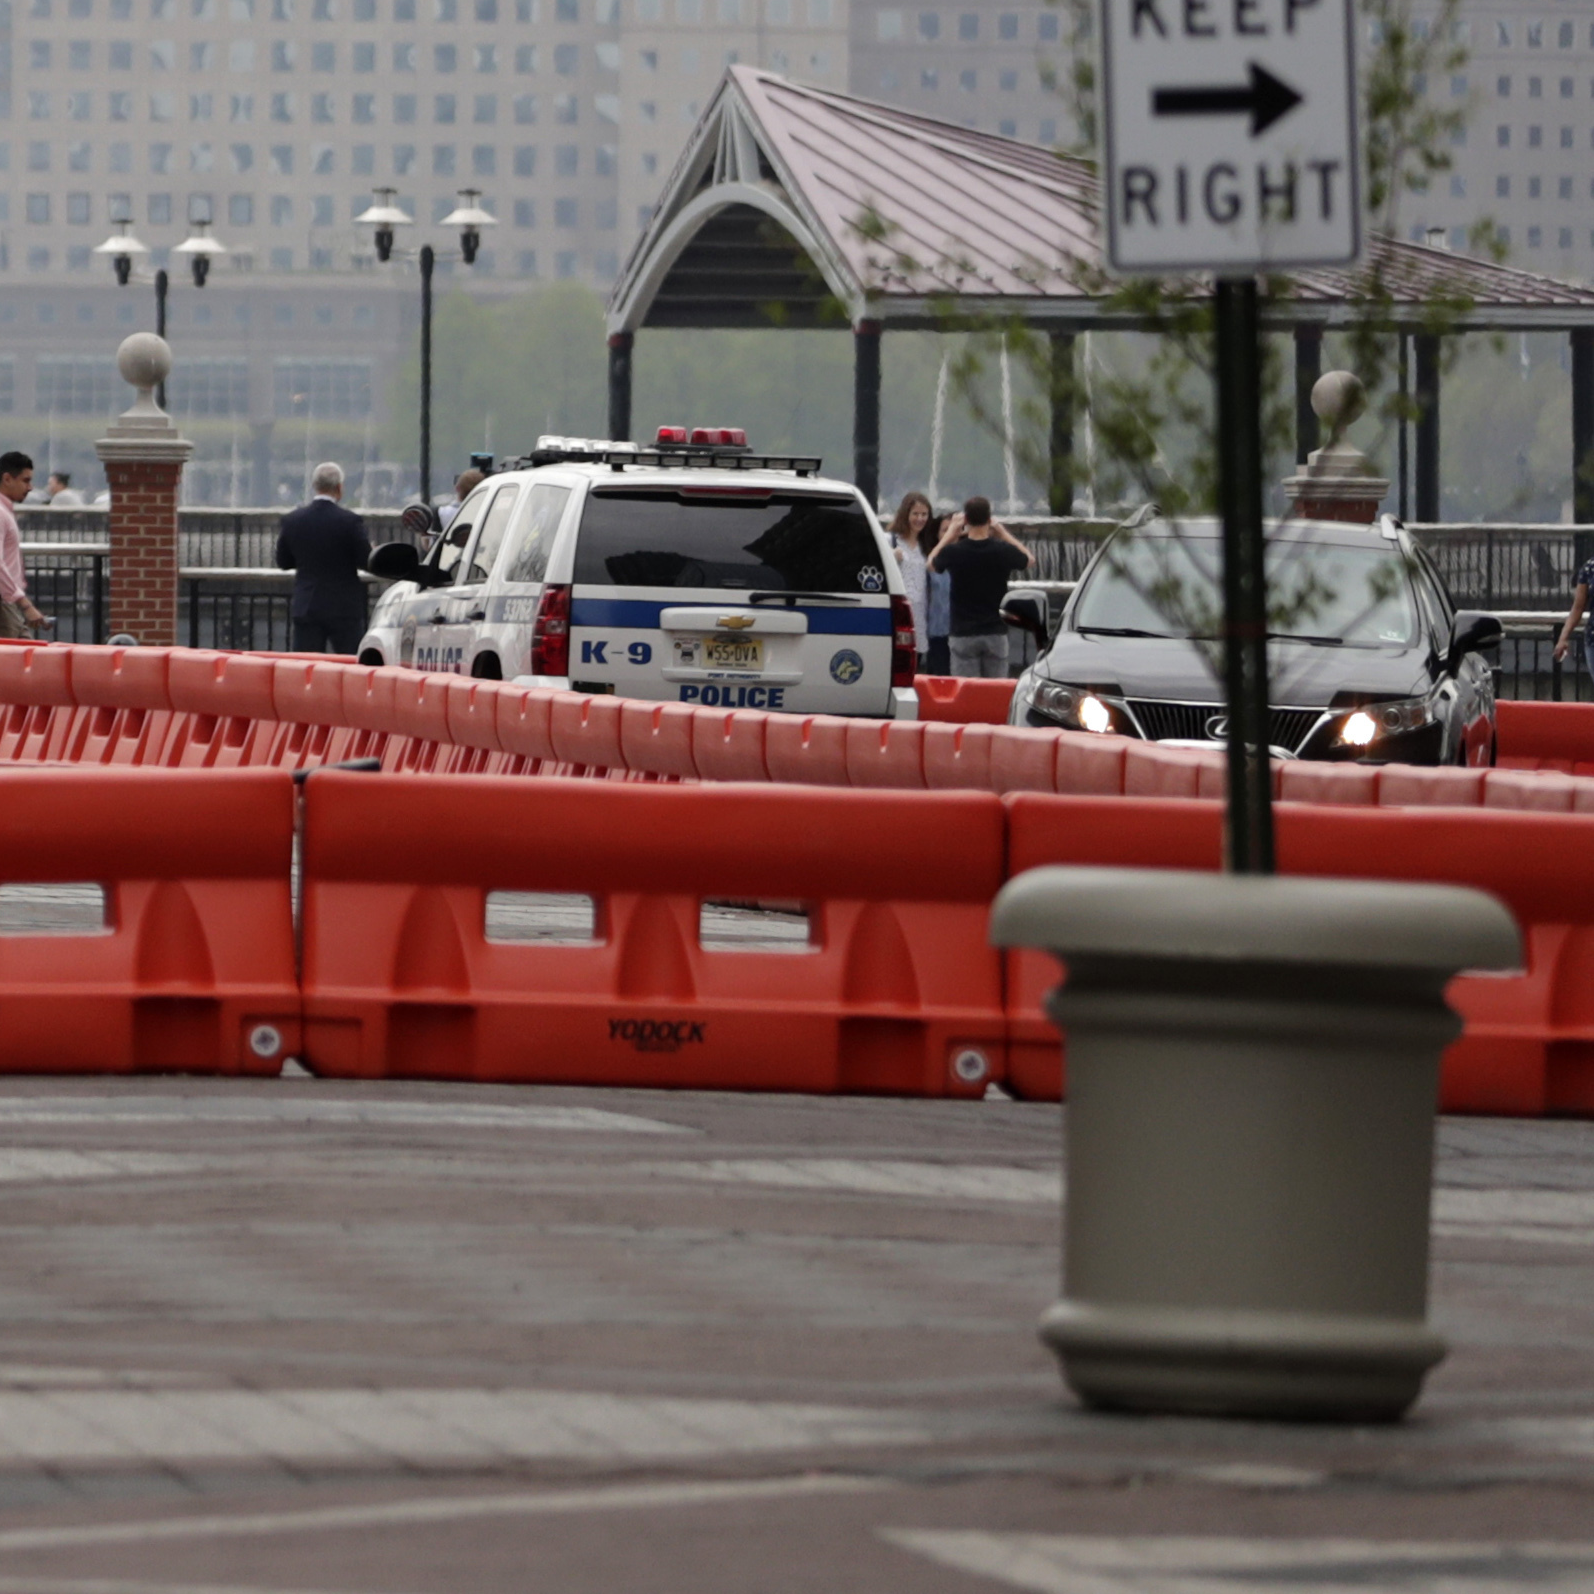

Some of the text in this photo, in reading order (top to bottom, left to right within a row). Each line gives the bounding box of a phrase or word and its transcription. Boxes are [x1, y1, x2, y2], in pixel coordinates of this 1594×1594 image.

[1120, 159, 1340, 226] RIGHT
[417, 647, 463, 674] POLICE
[581, 640, 652, 665] K-9
[679, 684, 785, 709] POLICE
[608, 1017, 707, 1044] YODOCK
